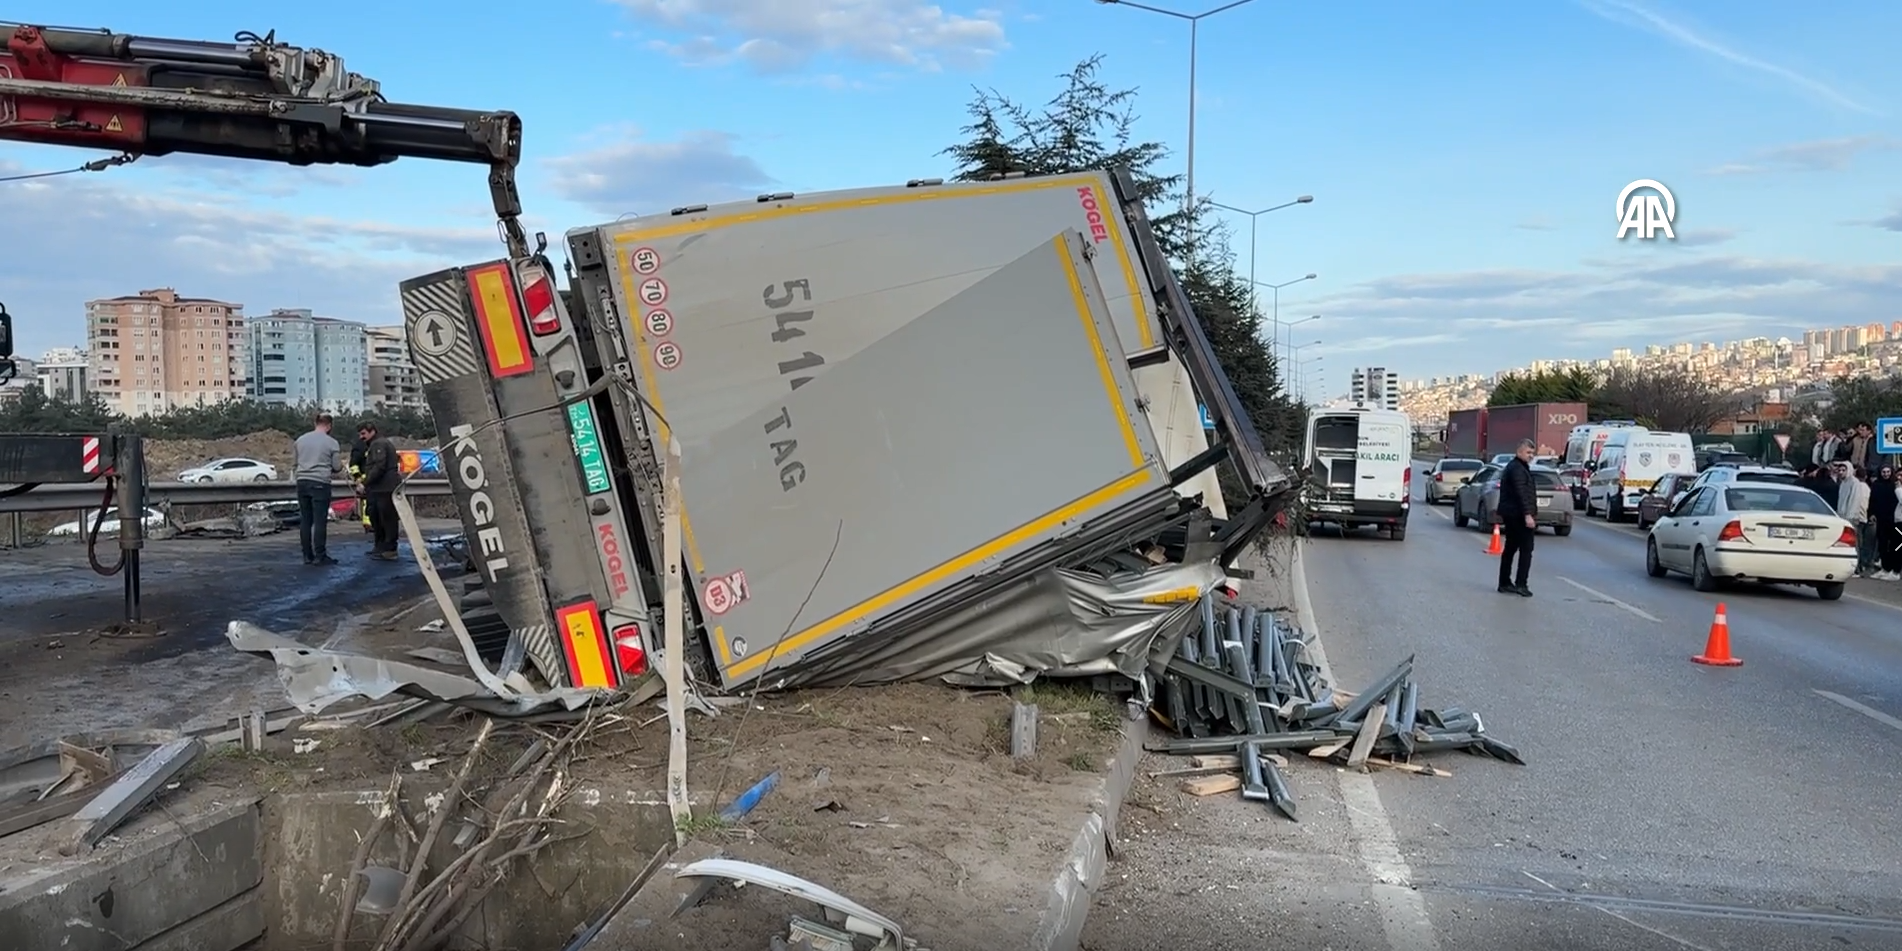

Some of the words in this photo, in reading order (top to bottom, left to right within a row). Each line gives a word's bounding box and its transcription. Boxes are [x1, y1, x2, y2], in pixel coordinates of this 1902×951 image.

[1077, 186, 1108, 245] KÖGEL
[637, 251, 655, 271] 50
[645, 281, 662, 302] 70
[651, 313, 668, 332] 80
[659, 345, 677, 366] 90
[1548, 413, 1578, 425] XPO
[764, 406, 806, 493] TAG
[1374, 453, 1400, 462] ARACI
[584, 459, 605, 487] TAG
[450, 423, 509, 584] KÖGEL
[598, 523, 629, 600] KÖGEL
[710, 585, 726, 607] D3
